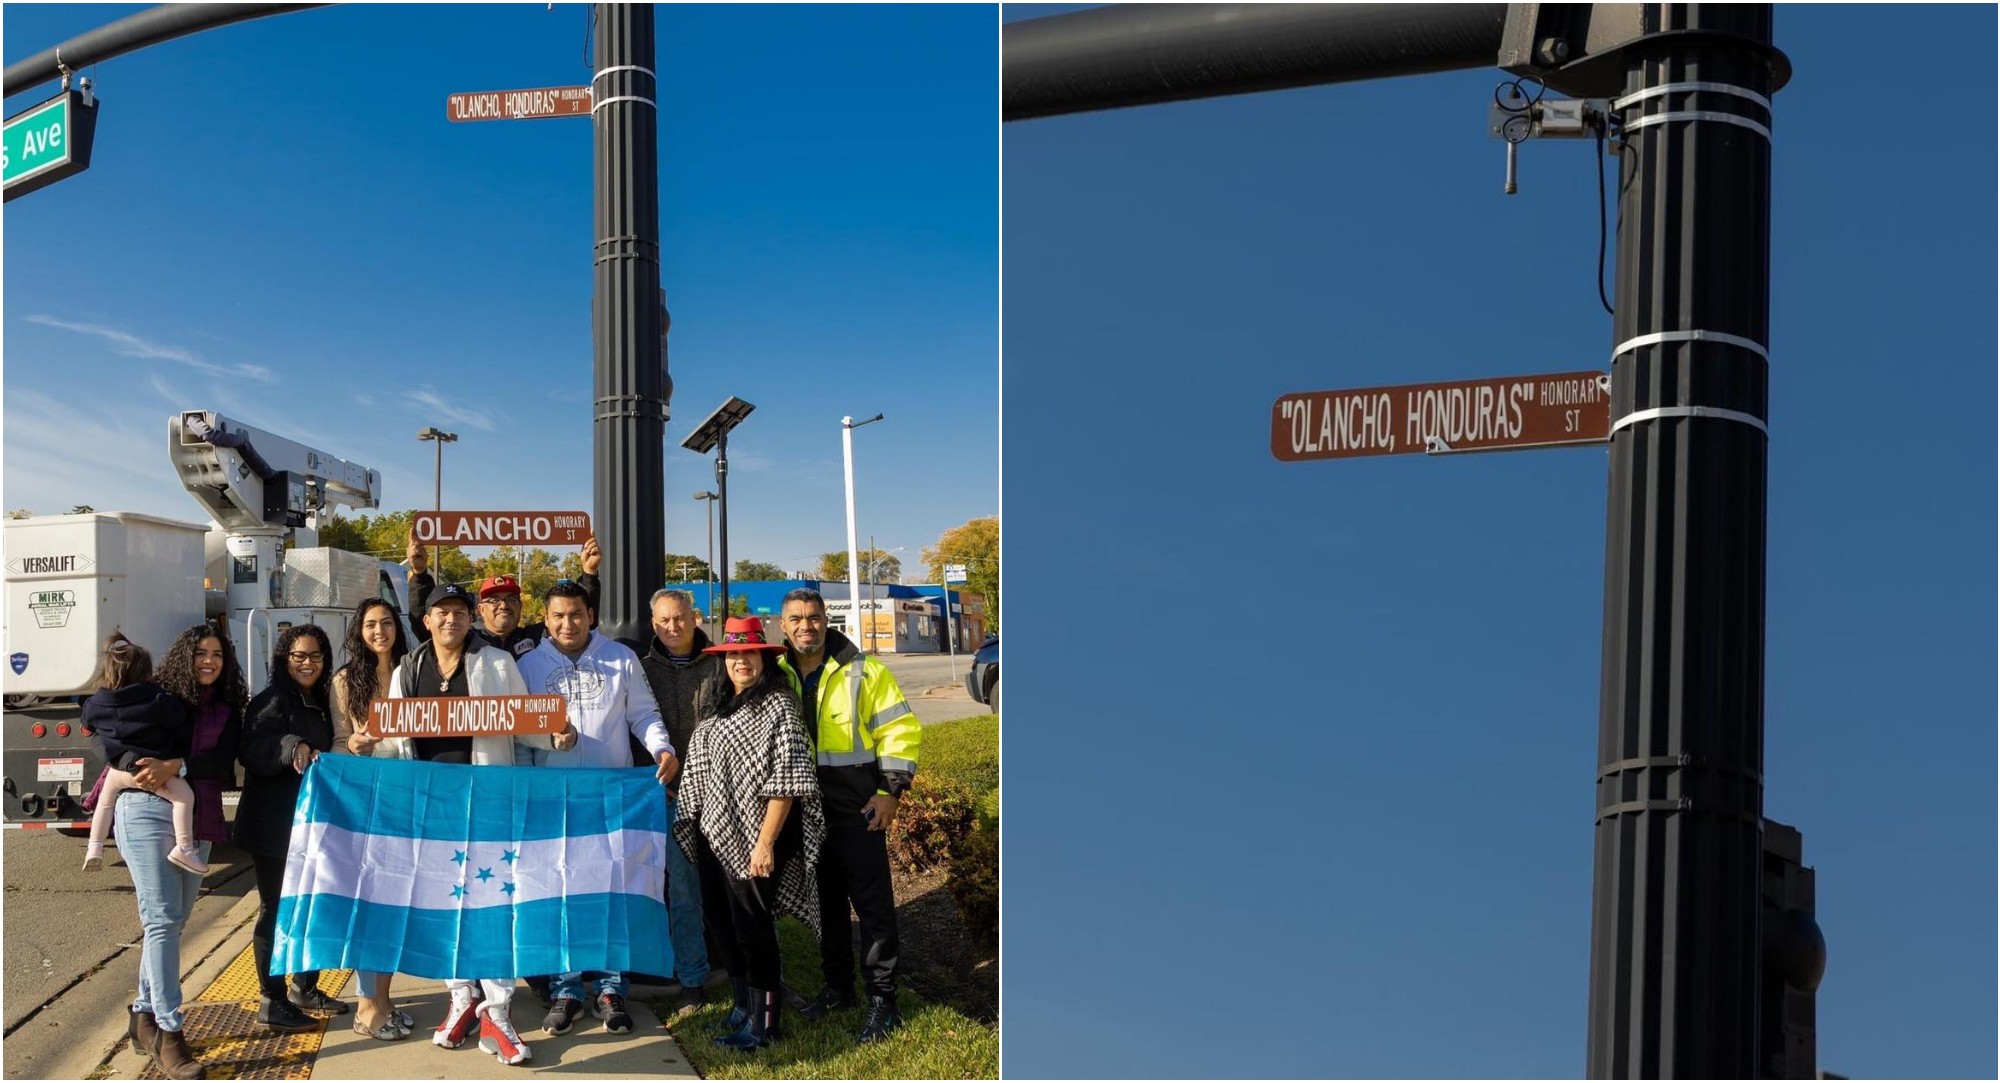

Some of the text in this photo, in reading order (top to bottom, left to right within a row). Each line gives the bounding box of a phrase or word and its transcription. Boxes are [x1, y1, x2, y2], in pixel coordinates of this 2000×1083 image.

[452, 90, 559, 118] "OLANCHO, HONDURAS"
[572, 101, 580, 111] ST
[22, 122, 62, 160] Ave
[1541, 378, 1601, 406] HONORARY
[1281, 383, 1534, 454] "OLANCHO, HONDURAS"
[1565, 410, 1580, 433] ST
[416, 516, 551, 541] OLANCHO
[554, 516, 586, 529] HONORARY
[566, 530, 576, 541] ST
[23, 555, 76, 573] VERSALIFT
[38, 592, 66, 603] MIRK
[524, 698, 560, 713] HONORARY
[374, 698, 522, 735] "OLANCHO, HONDURAS"
[538, 715, 548, 729] ST
